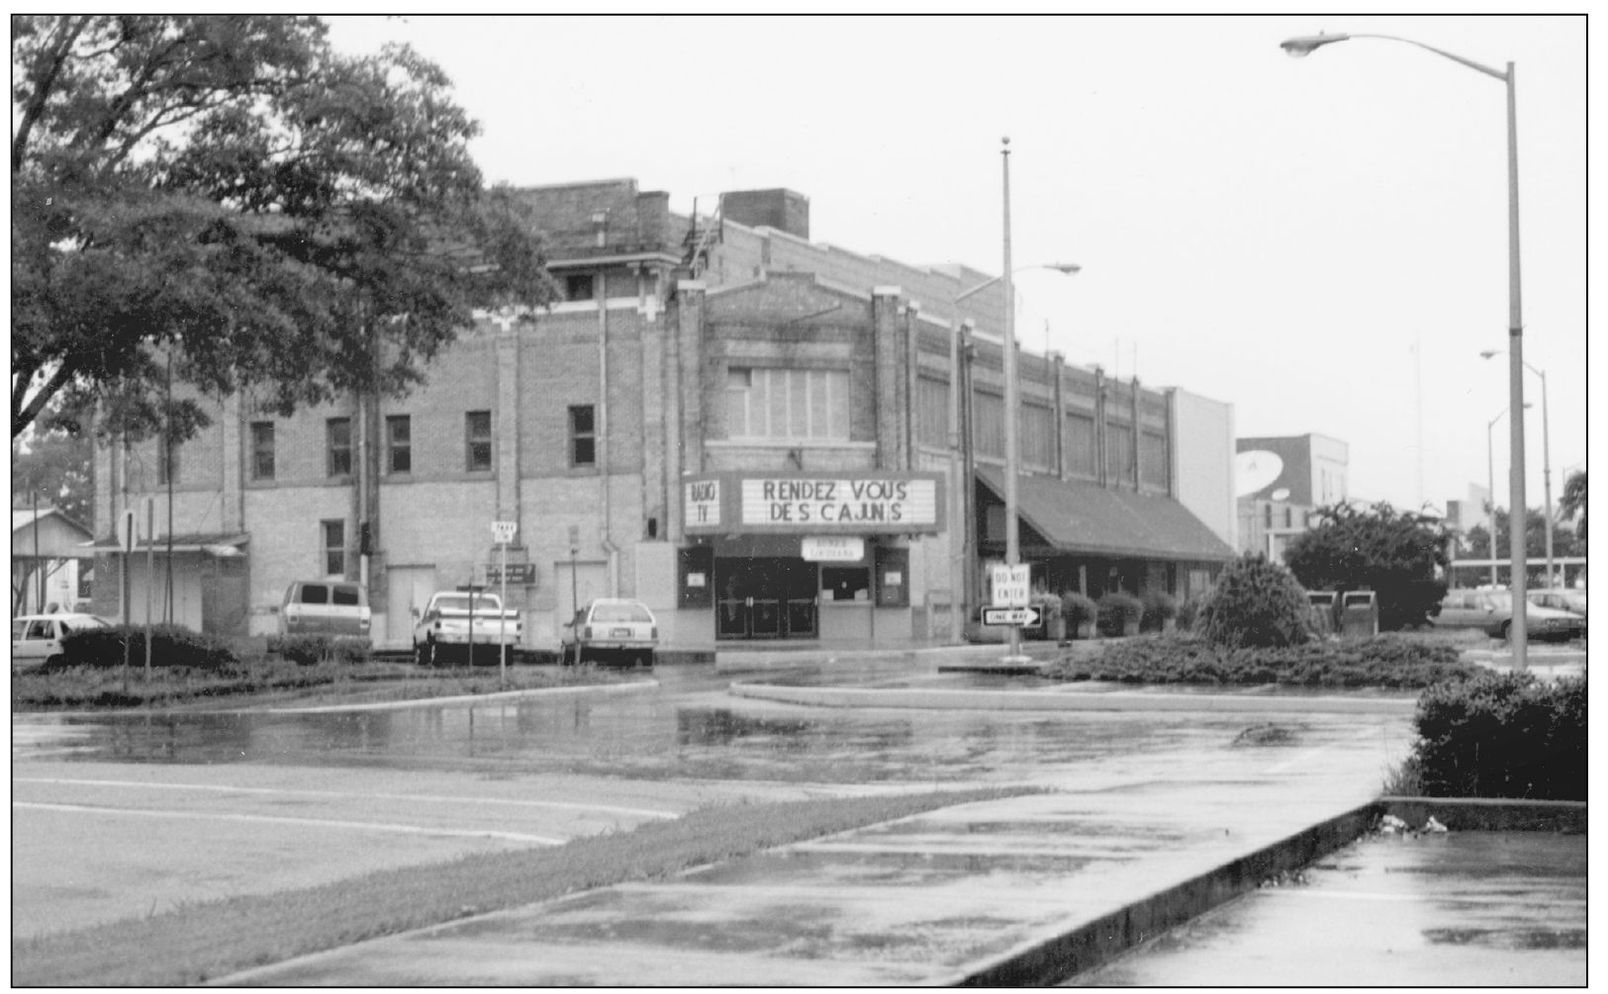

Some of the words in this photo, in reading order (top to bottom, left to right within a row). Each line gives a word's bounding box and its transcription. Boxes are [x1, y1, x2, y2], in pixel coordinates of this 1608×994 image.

[691, 483, 715, 502] RADIO
[764, 481, 836, 501] RENDEZ
[850, 481, 908, 500] VOUS
[697, 504, 708, 522] TV
[770, 503, 810, 521] DES
[820, 503, 902, 522] CAJUNS
[995, 572, 1007, 583] DO
[1010, 572, 1026, 583] NOT
[998, 588, 1025, 599] ENTER
[990, 612, 1006, 620] ONE
[1012, 612, 1028, 620] WAY
